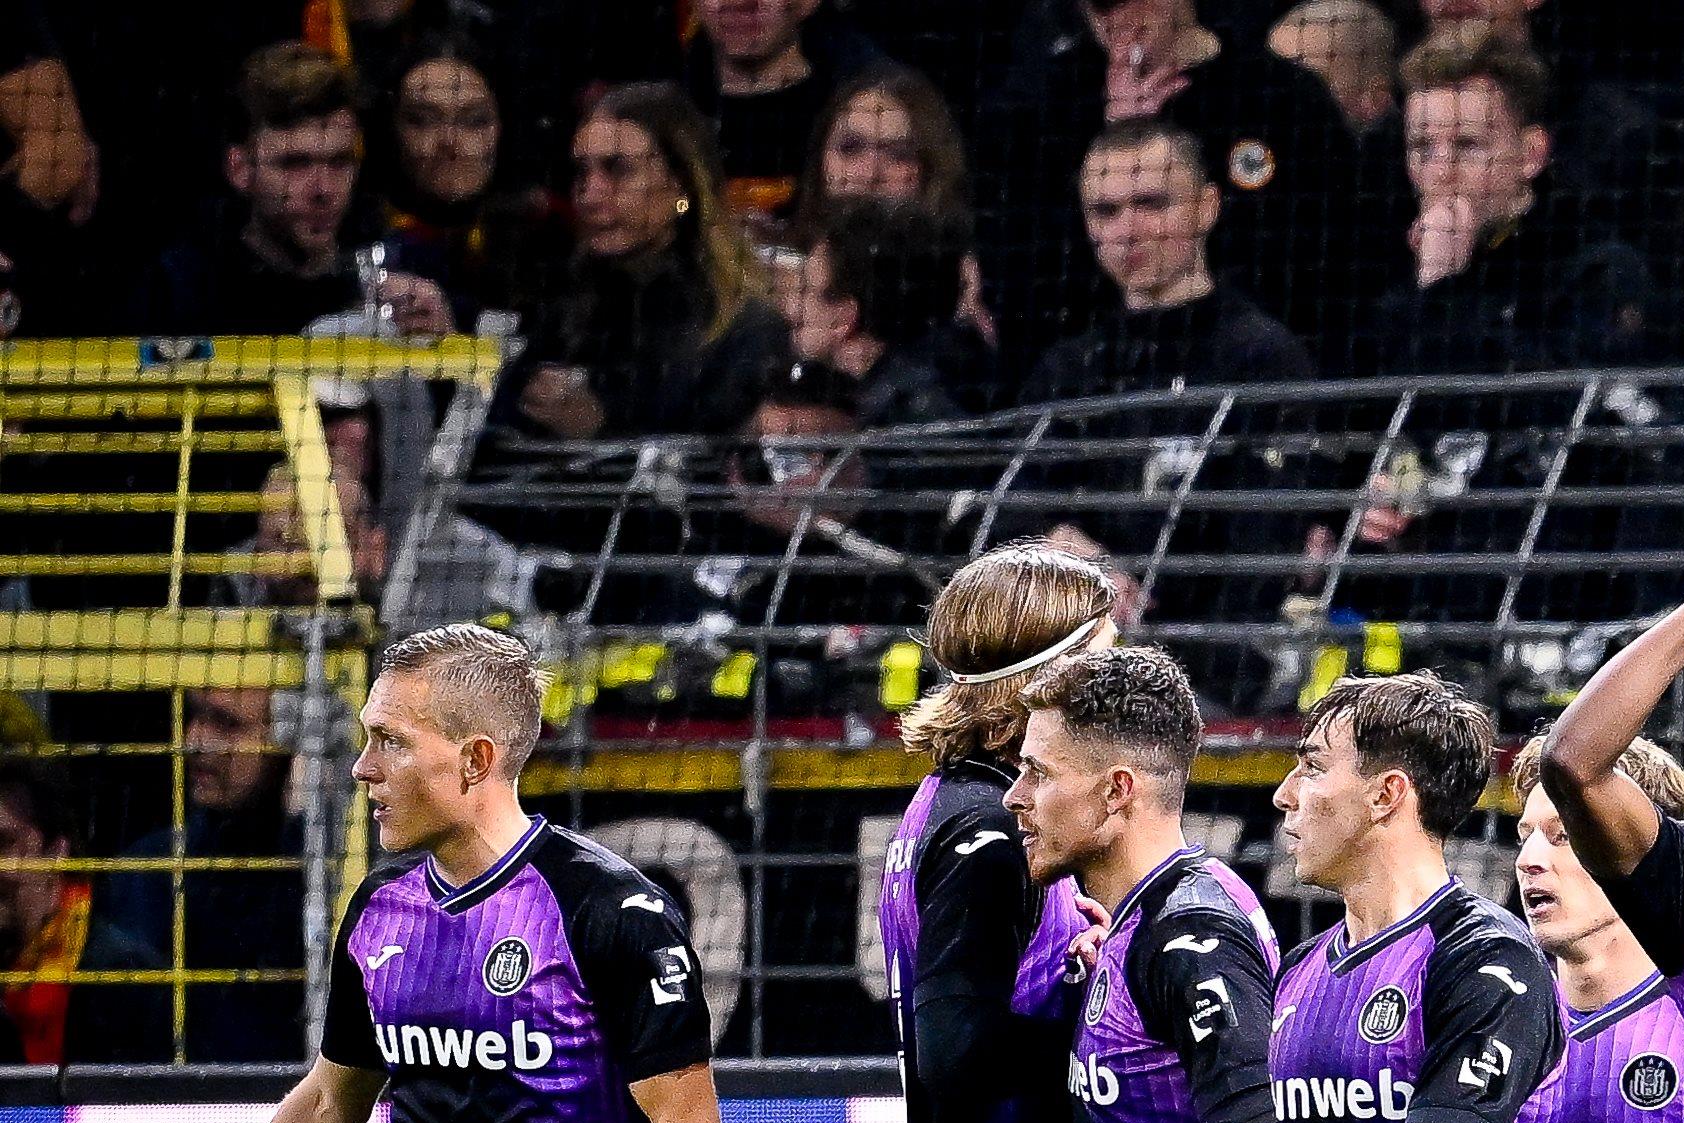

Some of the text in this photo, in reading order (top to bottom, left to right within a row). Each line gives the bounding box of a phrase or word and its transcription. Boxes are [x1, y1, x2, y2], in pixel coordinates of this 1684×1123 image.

[375, 1019, 553, 1071] unweb
[1068, 1051, 1120, 1106] web
[1270, 1067, 1416, 1122] unweb
